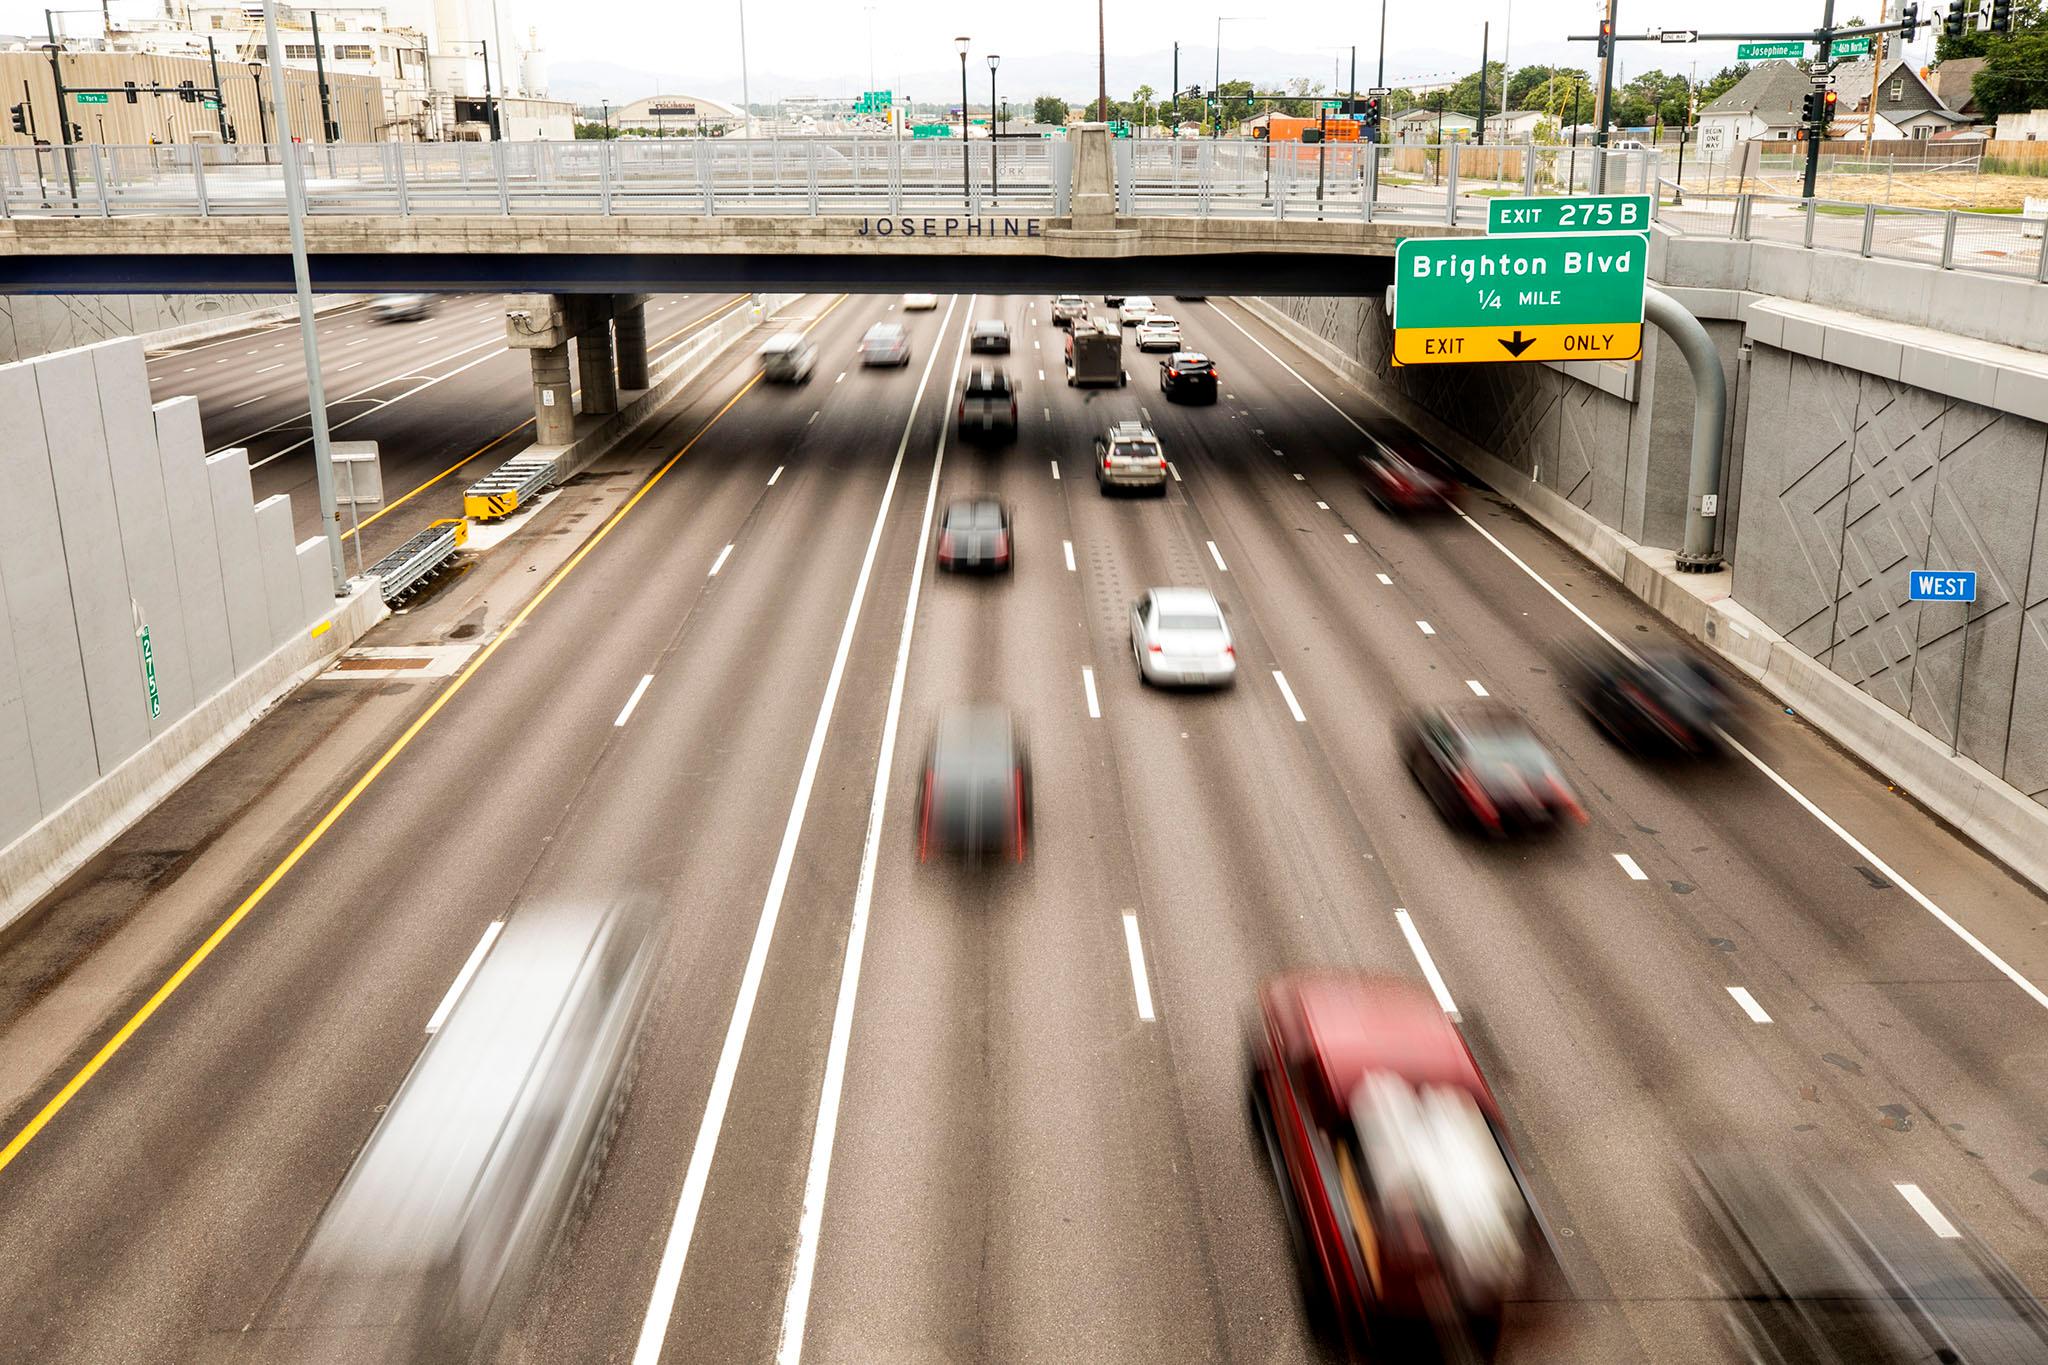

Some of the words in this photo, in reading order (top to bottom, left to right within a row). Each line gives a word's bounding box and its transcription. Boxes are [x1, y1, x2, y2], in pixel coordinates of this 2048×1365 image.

[1750, 45, 1789, 57] Josephine
[1500, 208, 1542, 224] EXIT
[858, 217, 1041, 237] JOSEPHINE
[1413, 254, 1547, 283] Brighton
[1563, 251, 1631, 274] Blvd
[1519, 290, 1561, 306] MILE
[1425, 338, 1465, 355] EXIT
[1563, 334, 1614, 351] ONLY
[1918, 575, 1967, 596] WEST
